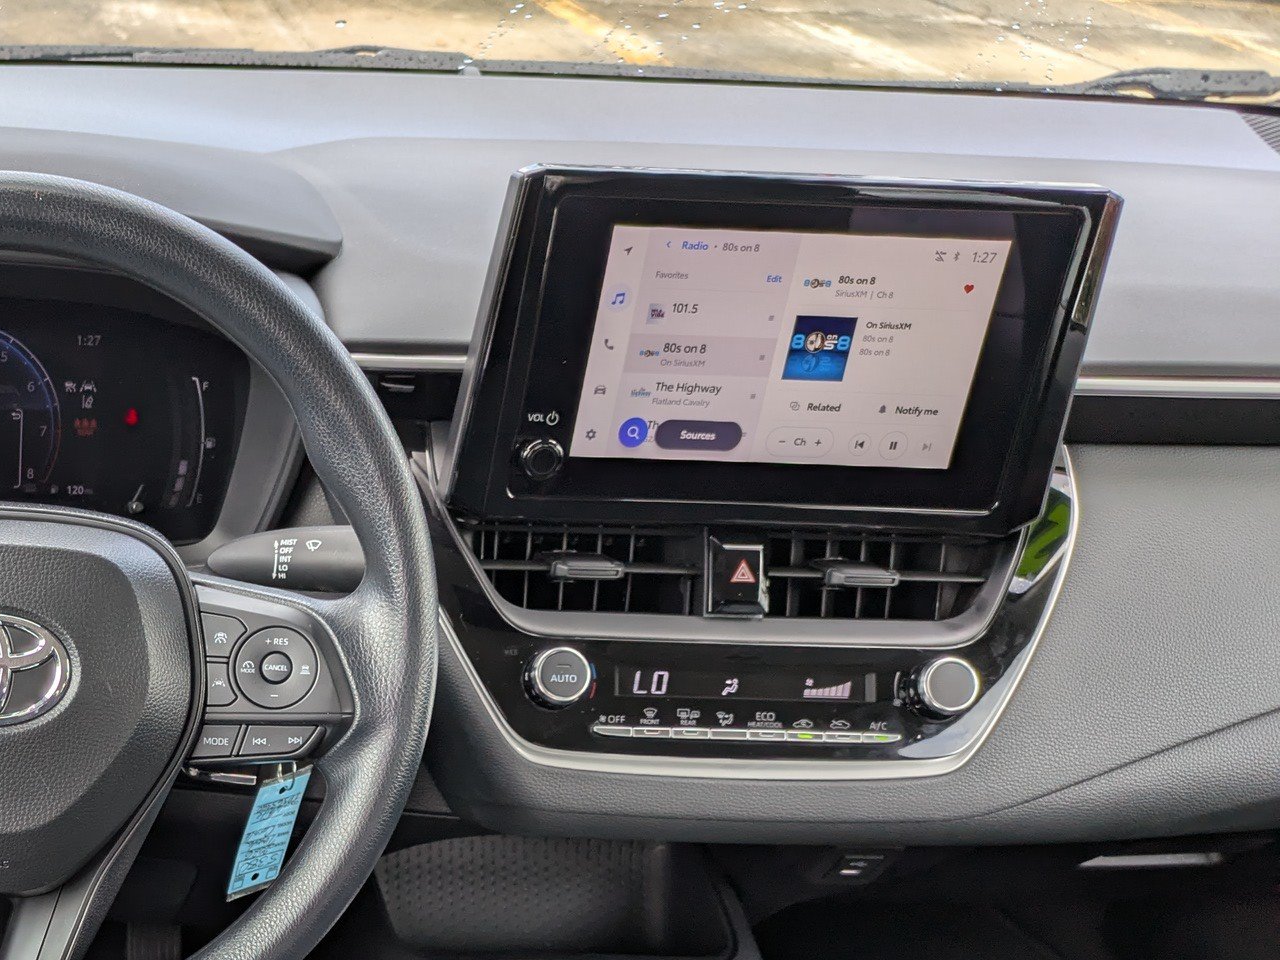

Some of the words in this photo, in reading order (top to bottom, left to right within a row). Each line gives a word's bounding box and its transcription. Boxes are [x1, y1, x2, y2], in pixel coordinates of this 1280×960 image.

[682, 241, 708, 250] Radio
[722, 243, 738, 251] 80s
[740, 244, 752, 252] on
[754, 244, 760, 252] 8
[971, 251, 998, 264] 1:27
[655, 271, 689, 280] Favorites
[767, 275, 782, 283] Edit
[838, 276, 854, 285] 80s
[869, 277, 876, 285] 8
[835, 289, 867, 299] SiriusXM
[876, 291, 888, 299] Ch
[888, 291, 894, 299] 8
[672, 303, 699, 314] 101.5
[866, 321, 877, 329] On
[878, 321, 912, 330] SiriusXM
[77, 335, 101, 346] 1:27
[863, 335, 876, 343] 80s
[663, 343, 681, 354] 80s
[684, 345, 697, 354] on
[700, 344, 707, 354] 8
[859, 348, 872, 356] 80s
[884, 349, 890, 357] 8
[0, 352, 8, 362] 5
[673, 360, 706, 368] SiriusXM
[27, 382, 35, 392] 6
[202, 381, 209, 392] F
[655, 382, 674, 392] The
[675, 382, 722, 396] Highway
[682, 399, 710, 408] Cavalry
[807, 403, 842, 412] Related
[895, 406, 923, 417] Notify
[923, 408, 939, 416] me
[528, 413, 544, 422] VOL
[40, 426, 47, 436] 7
[680, 430, 716, 441] Sources
[794, 438, 806, 446] Ch
[27, 469, 34, 479] 8
[67, 485, 84, 495] 120
[264, 664, 288, 672] CANCEL
[550, 674, 577, 683] AUTO
[633, 670, 669, 695] LO
[608, 715, 626, 724] OFF
[756, 712, 776, 721] ECO
[869, 721, 887, 731] A/C
[203, 737, 229, 746] MODE
